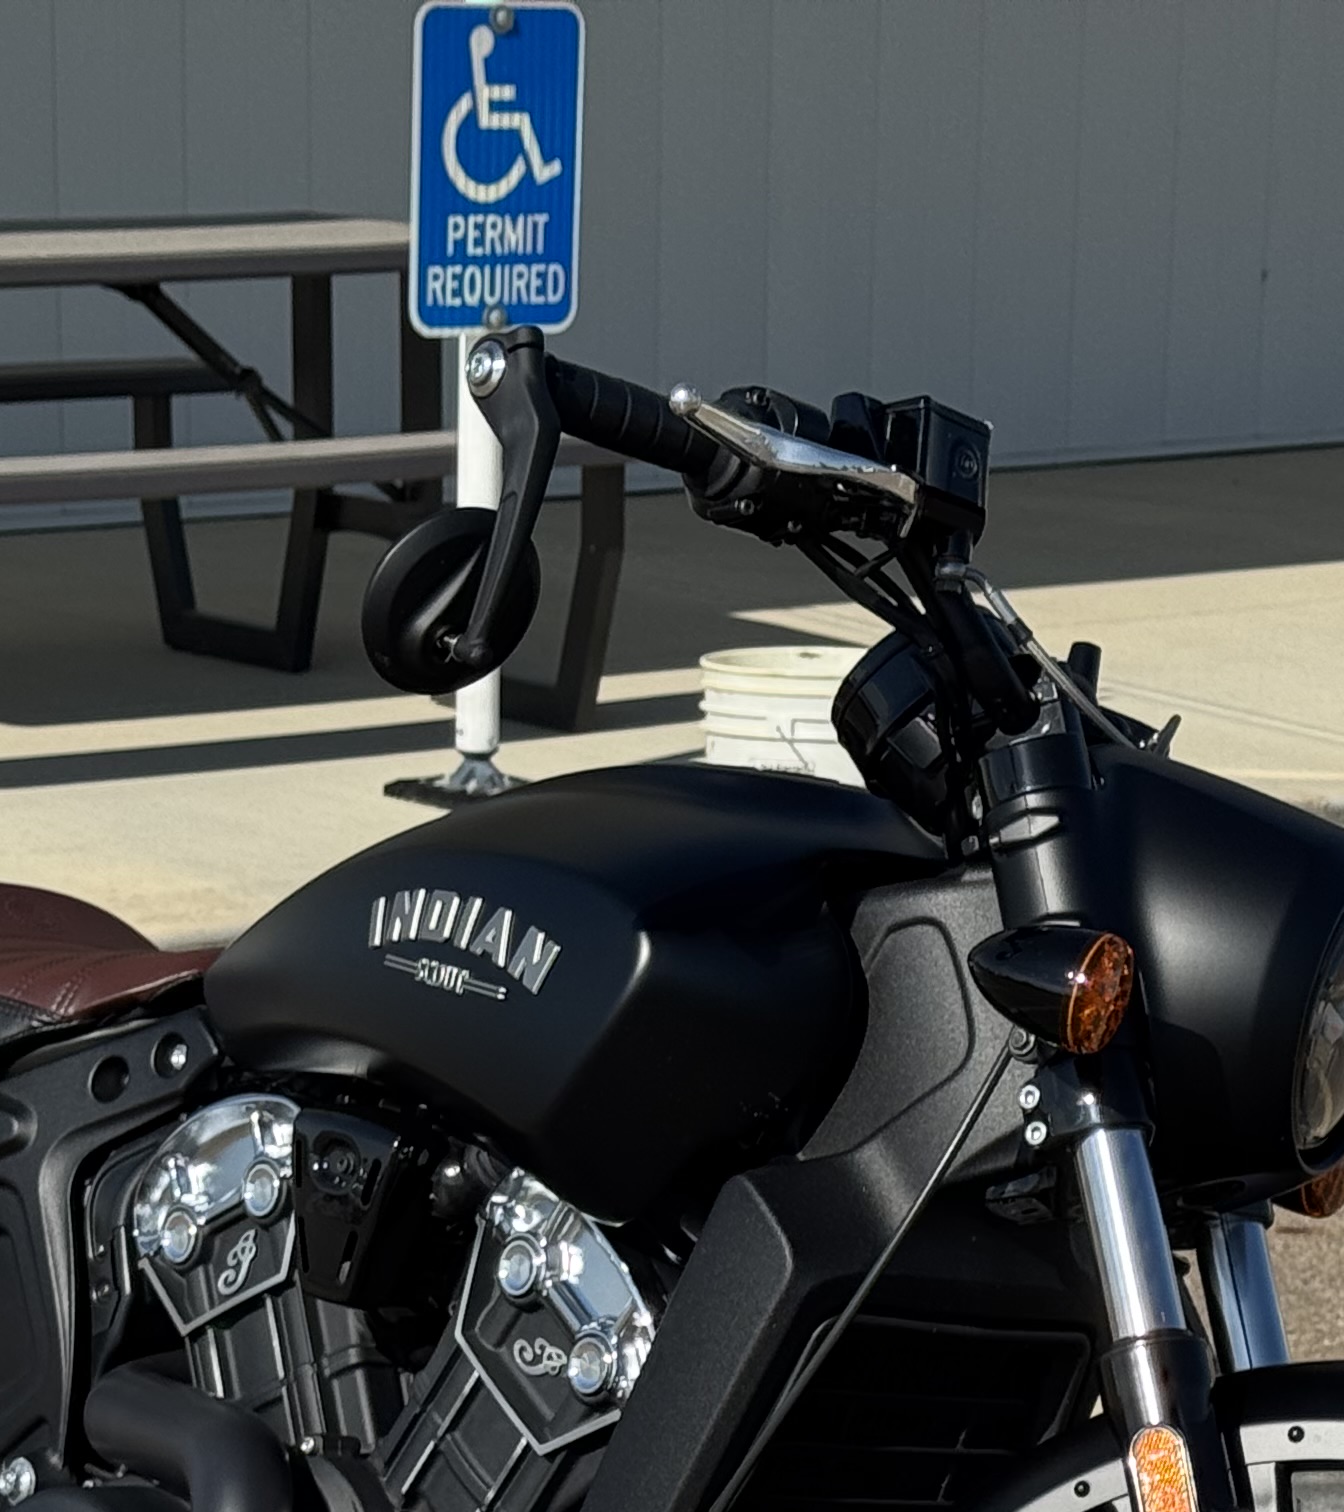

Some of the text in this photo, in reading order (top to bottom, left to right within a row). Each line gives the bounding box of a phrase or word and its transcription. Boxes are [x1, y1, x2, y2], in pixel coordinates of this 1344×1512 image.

[446, 213, 550, 258] PERMIT
[426, 262, 566, 307] REQUIRED
[368, 888, 562, 996] INDIAN
